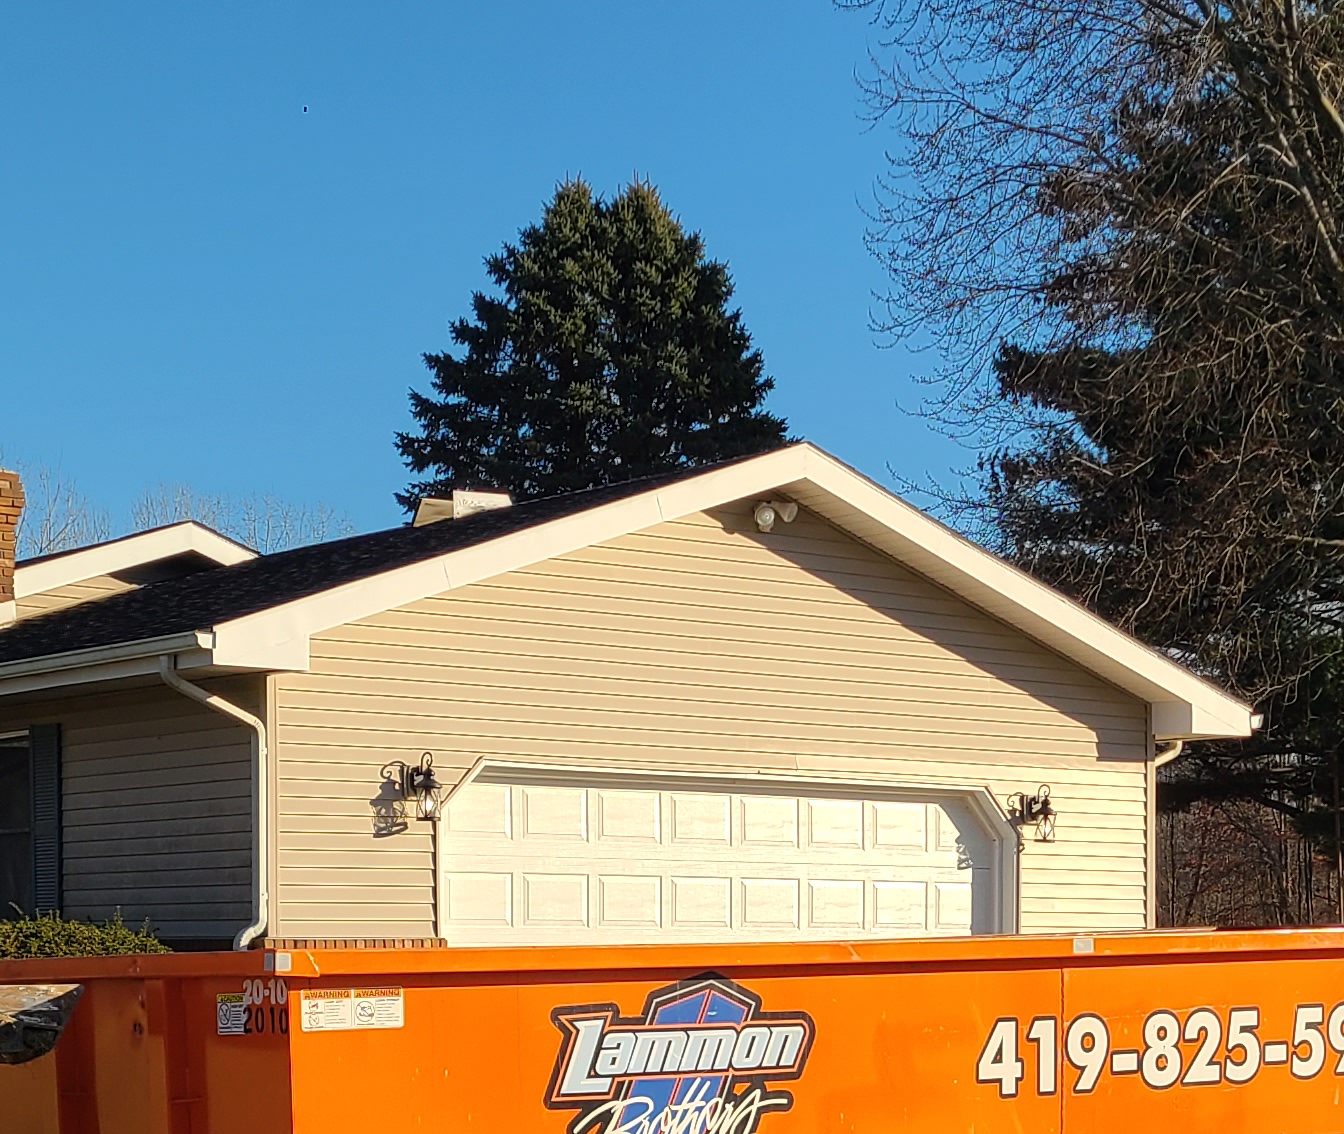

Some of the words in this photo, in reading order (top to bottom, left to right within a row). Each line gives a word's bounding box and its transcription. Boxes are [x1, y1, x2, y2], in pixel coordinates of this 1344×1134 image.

[243, 979, 288, 1005] 20-10
[310, 990, 350, 999] WARNING
[361, 988, 400, 998] WARNING
[243, 1007, 288, 1034] 2010
[557, 1014, 807, 1097] Lammon
